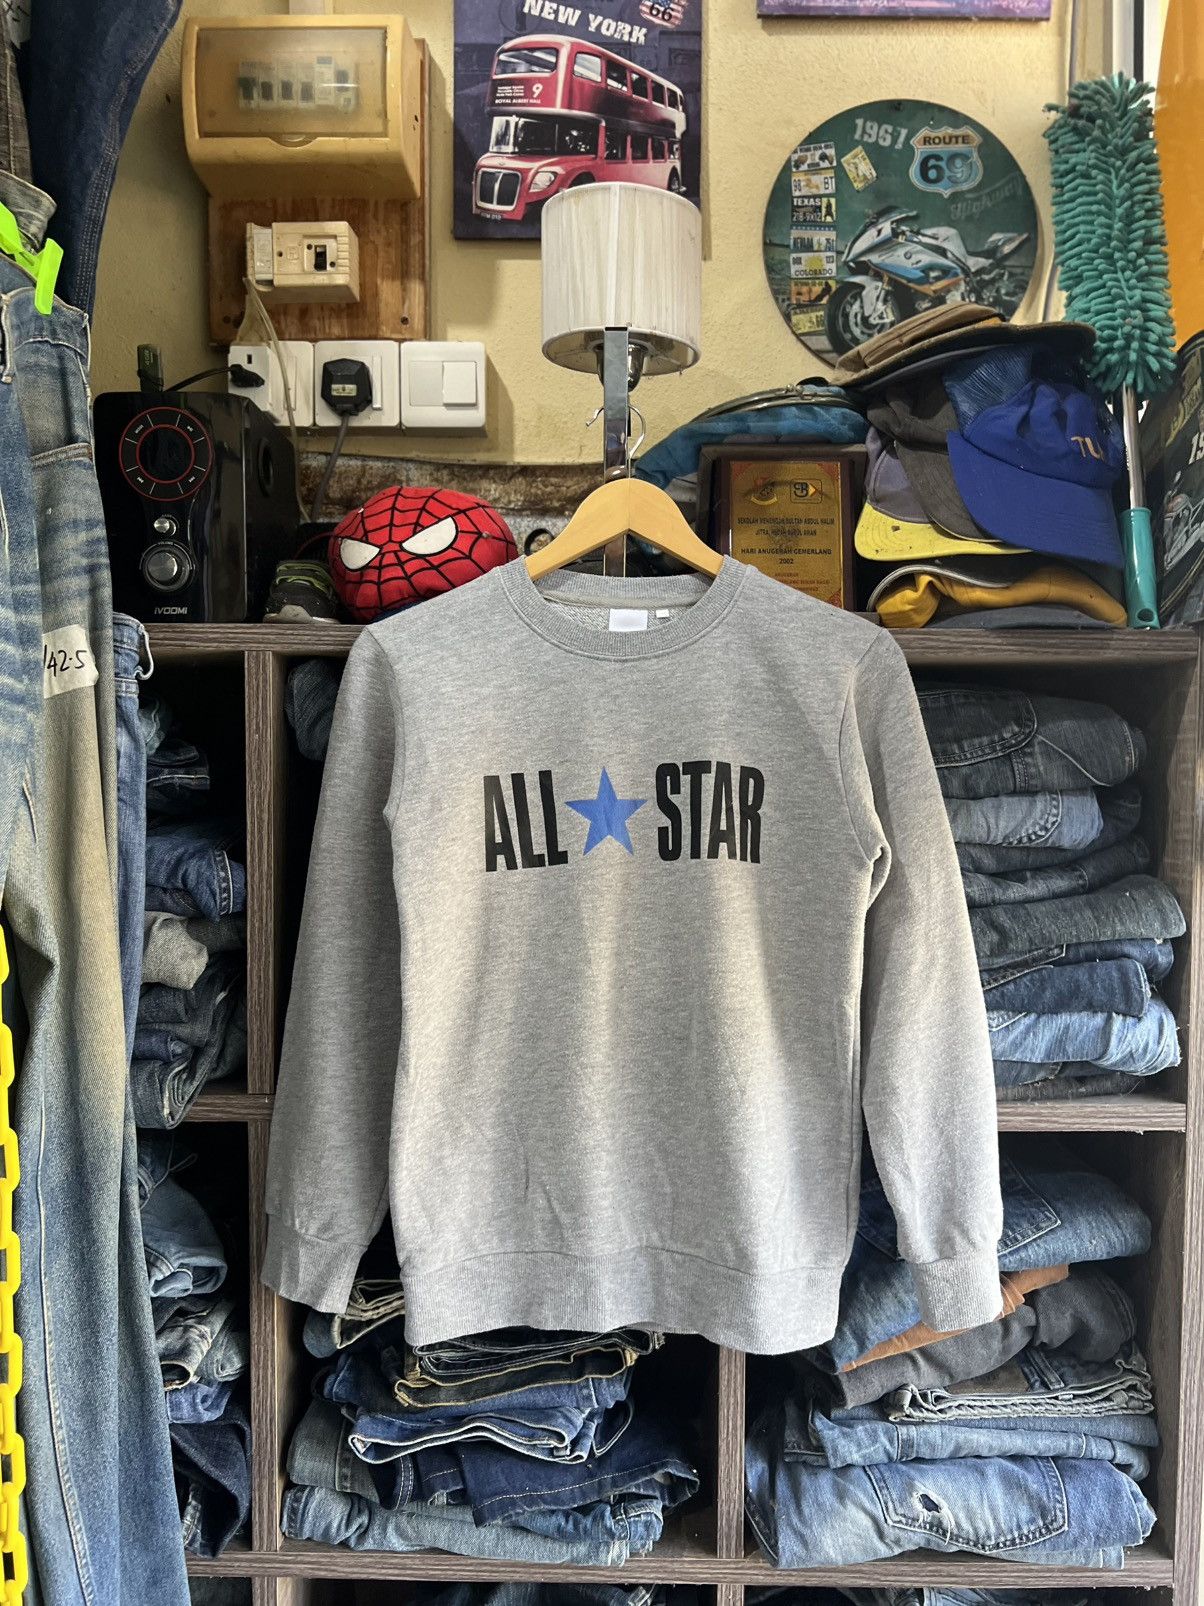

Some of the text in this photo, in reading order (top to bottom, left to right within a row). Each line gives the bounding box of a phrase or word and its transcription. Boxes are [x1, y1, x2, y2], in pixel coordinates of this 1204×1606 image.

[649, 3, 674, 22] 66
[522, 0, 649, 45] NEW YORK
[532, 83, 543, 98] 9
[923, 135, 971, 146] ROUTE
[920, 152, 974, 185] 69
[793, 198, 821, 206] TEXAS
[794, 268, 833, 277] COLORADO
[483, 760, 765, 873] ALL STAR
